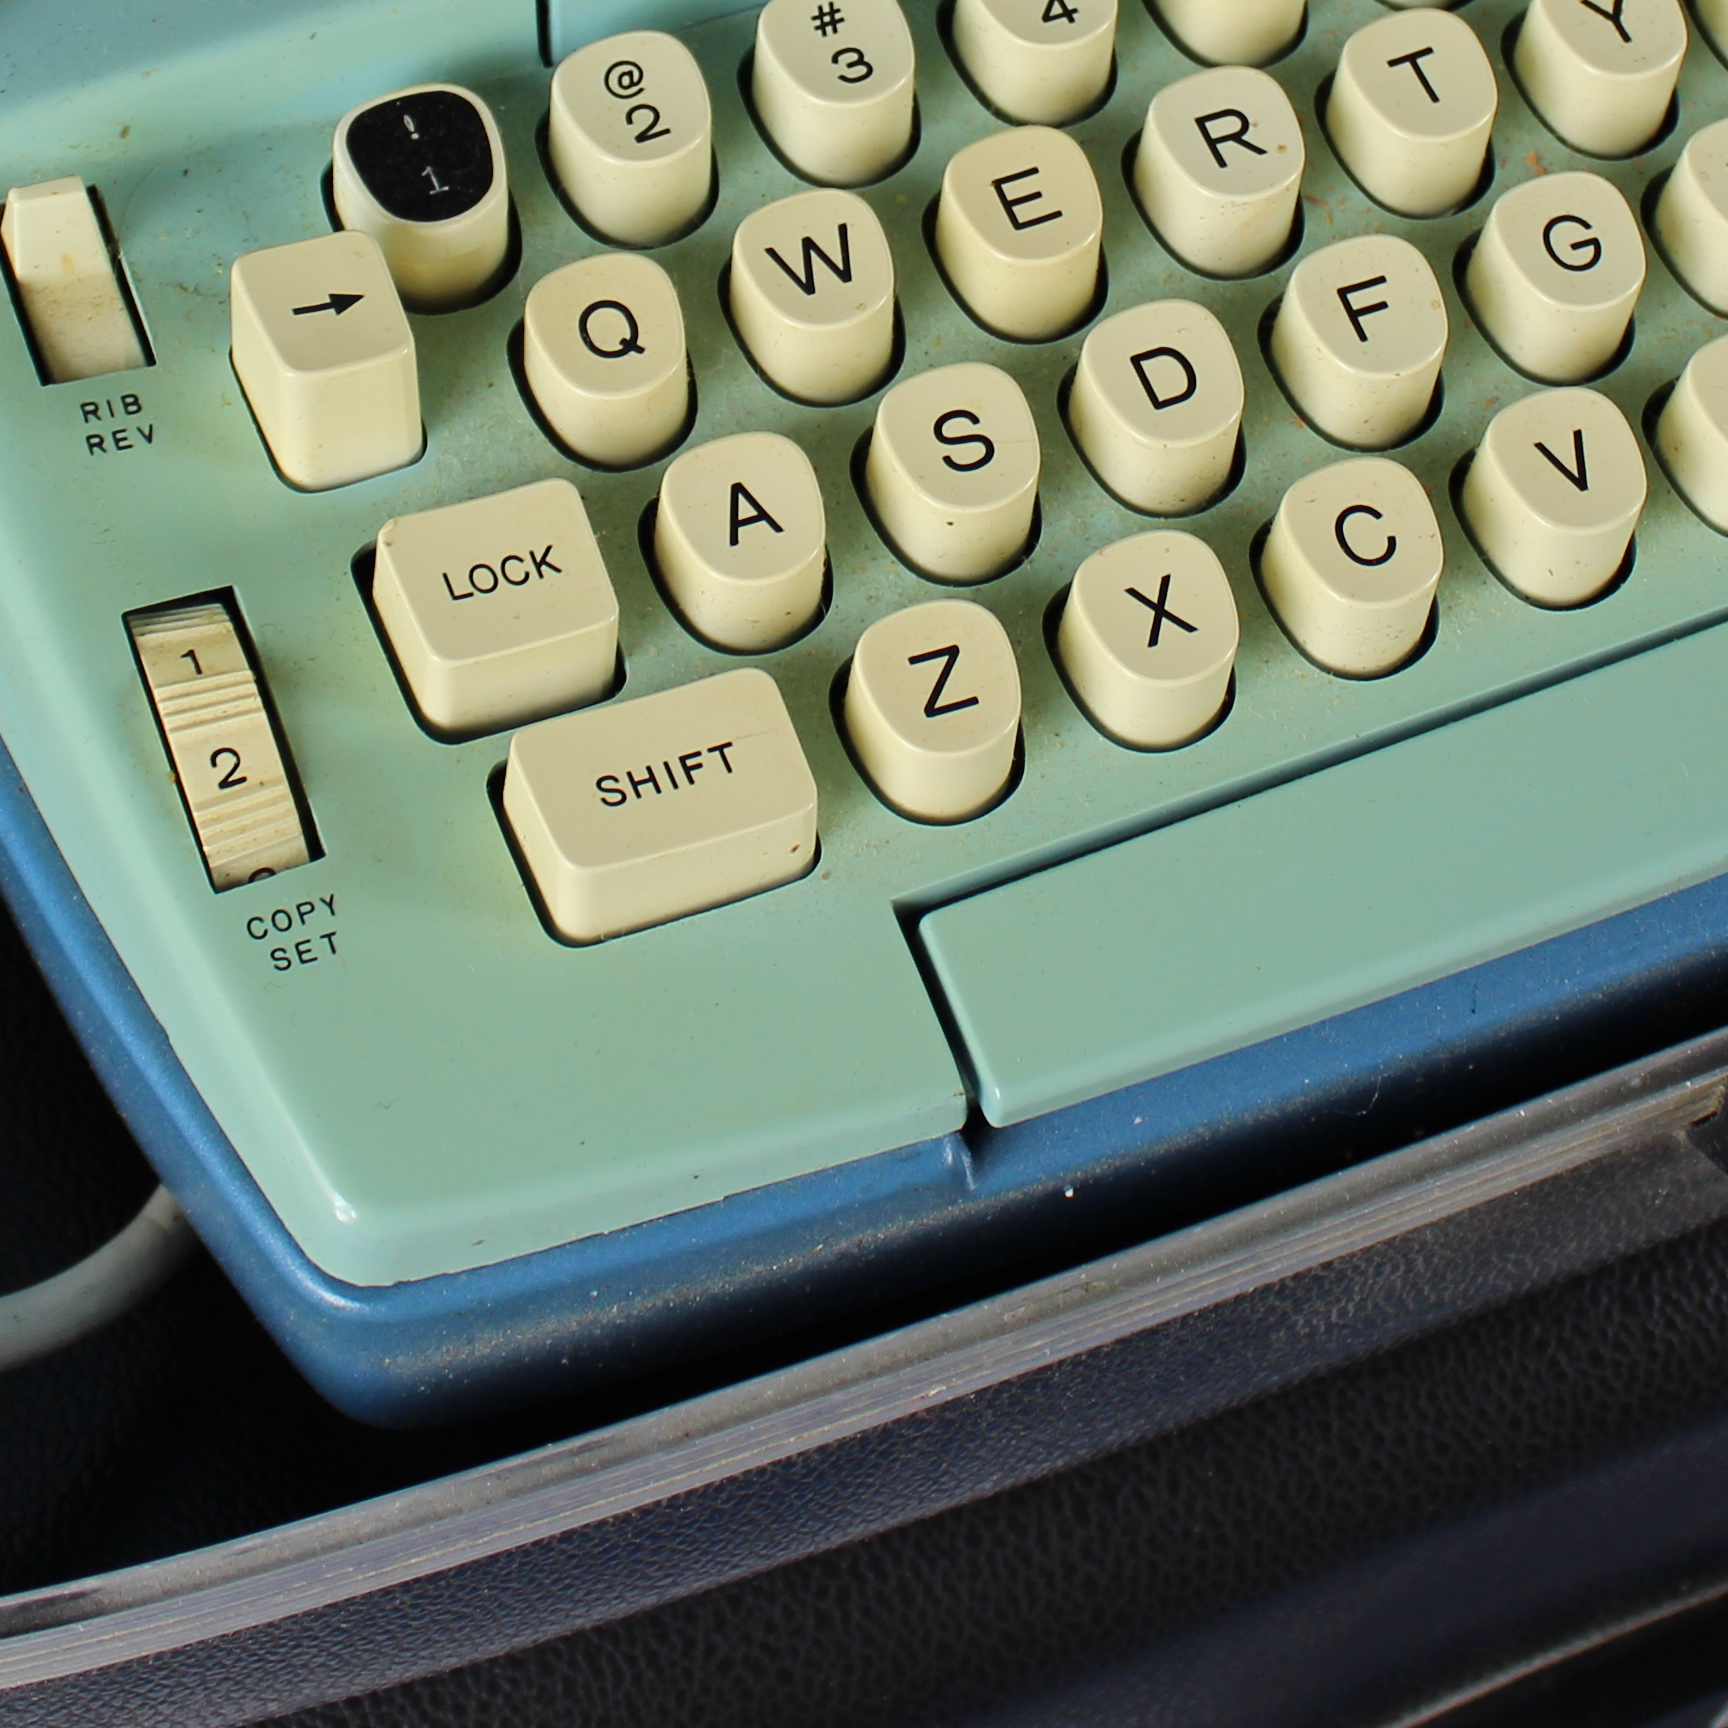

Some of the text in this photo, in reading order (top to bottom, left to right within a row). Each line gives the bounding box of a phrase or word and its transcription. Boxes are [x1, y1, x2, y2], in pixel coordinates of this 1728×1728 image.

[811, 1, 845, 38] #
[603, 60, 645, 100] @
[831, 47, 874, 84] 3
[1386, 46, 1440, 104] T
[625, 103, 671, 144] 2
[1194, 108, 1268, 169] R
[421, 166, 450, 195] 1
[991, 166, 1063, 231] E
[764, 222, 853, 296] W
[1542, 214, 1602, 272] G
[578, 299, 646, 359] Q
[1336, 275, 1389, 343] F
[1129, 346, 1197, 411] D
[79, 393, 143, 424] RIB
[85, 423, 153, 456] REV
[933, 409, 995, 473] S
[1533, 428, 1589, 492] V
[729, 482, 784, 547] A
[1334, 504, 1397, 567] C
[442, 544, 562, 601] LOCK
[1124, 574, 1198, 648] X
[180, 649, 203, 675] 1
[907, 644, 980, 718] Z
[209, 747, 248, 790] 2
[595, 741, 733, 807] SHIFT
[246, 894, 341, 942] COPY
[270, 932, 342, 972] SET
